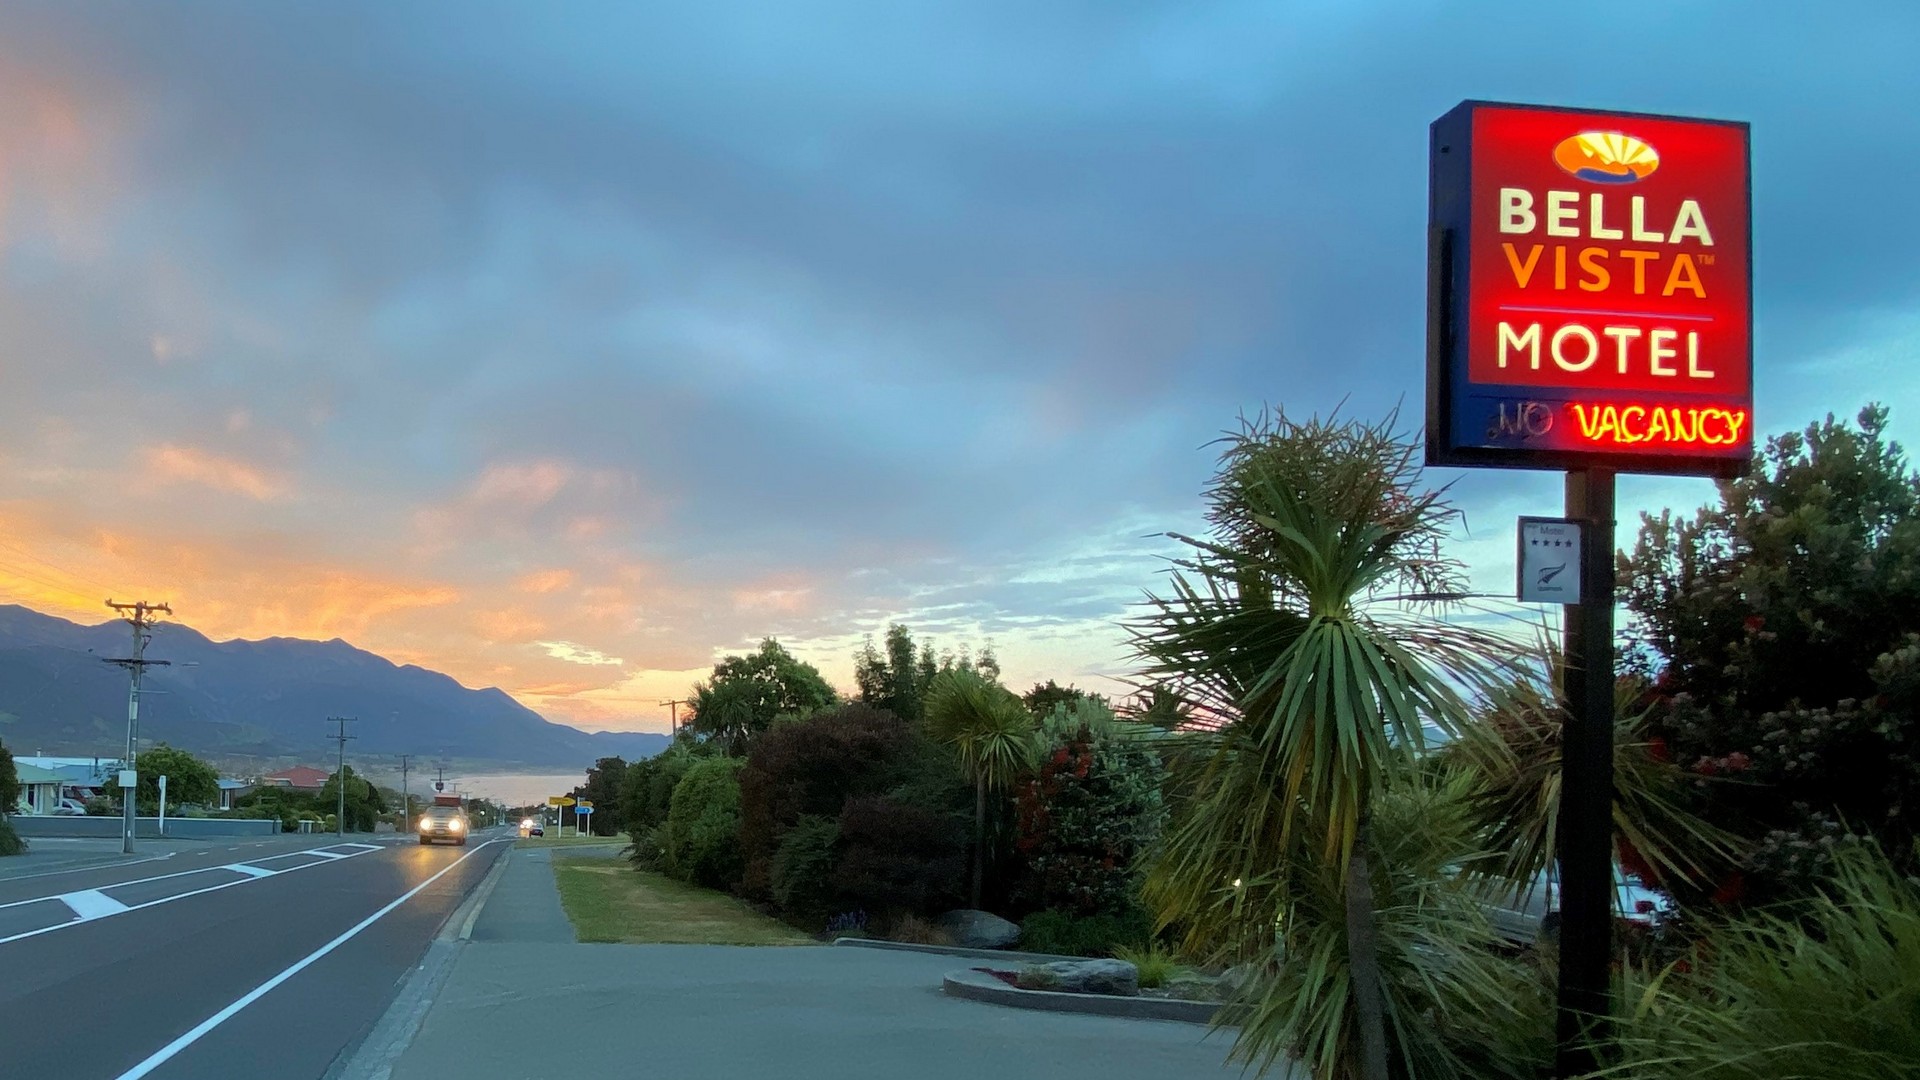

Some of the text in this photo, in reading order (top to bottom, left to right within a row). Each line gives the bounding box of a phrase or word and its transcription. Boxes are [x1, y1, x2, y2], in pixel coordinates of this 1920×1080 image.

[1499, 188, 1714, 246] BELLA
[1502, 243, 1706, 298] VISTA
[1498, 322, 1715, 378] MOTEL
[1490, 402, 1745, 444] NO VACANCY
